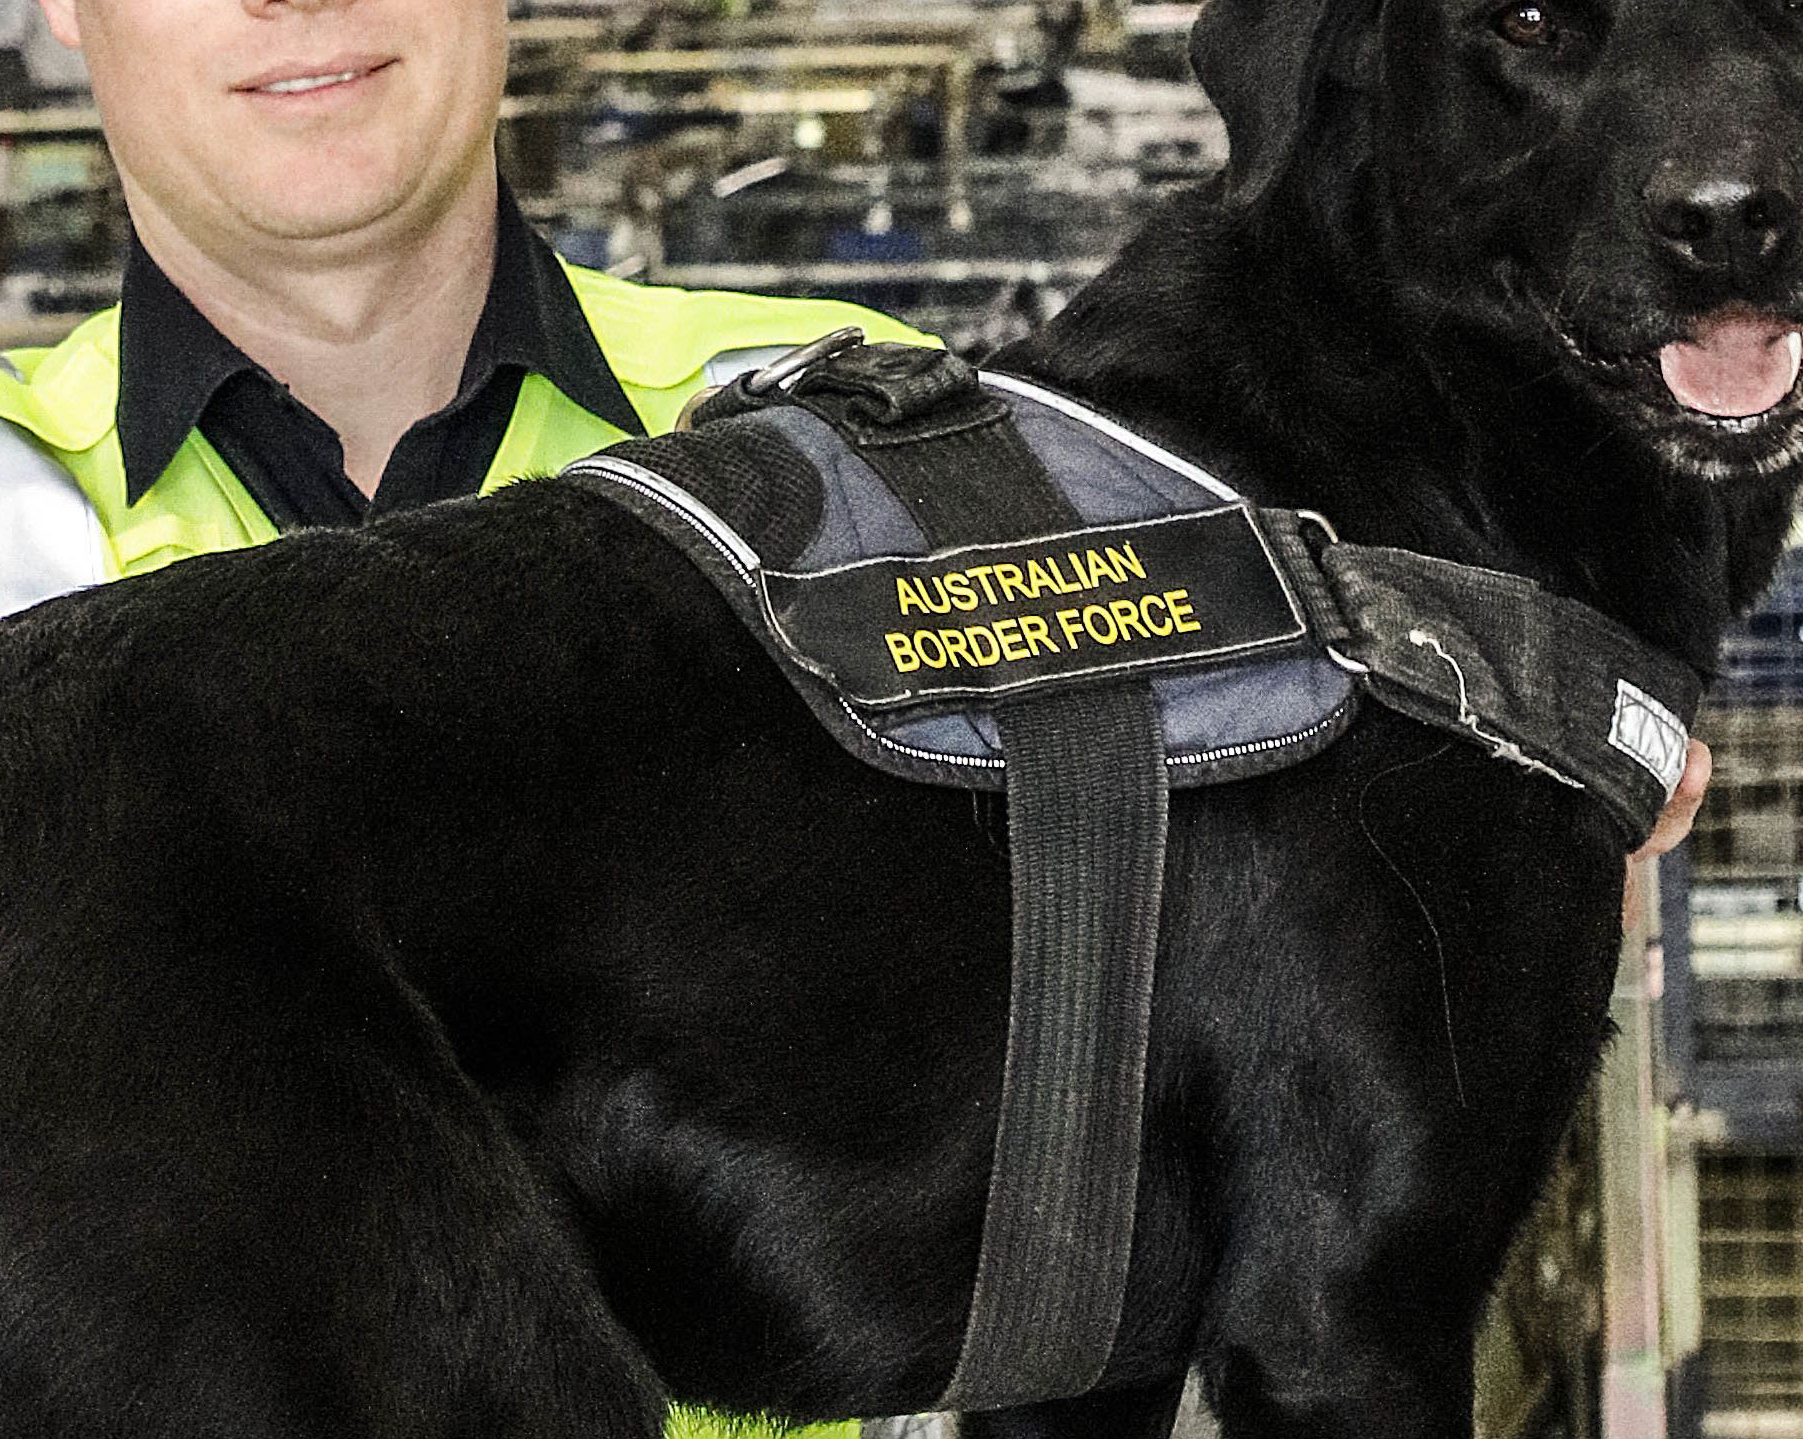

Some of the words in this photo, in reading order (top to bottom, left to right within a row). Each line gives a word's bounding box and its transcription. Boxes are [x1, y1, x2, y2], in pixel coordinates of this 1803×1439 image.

[896, 541, 1146, 615] AUSTRALIAN
[884, 615, 1060, 672] BORDER
[1056, 589, 1202, 650] FORCE
